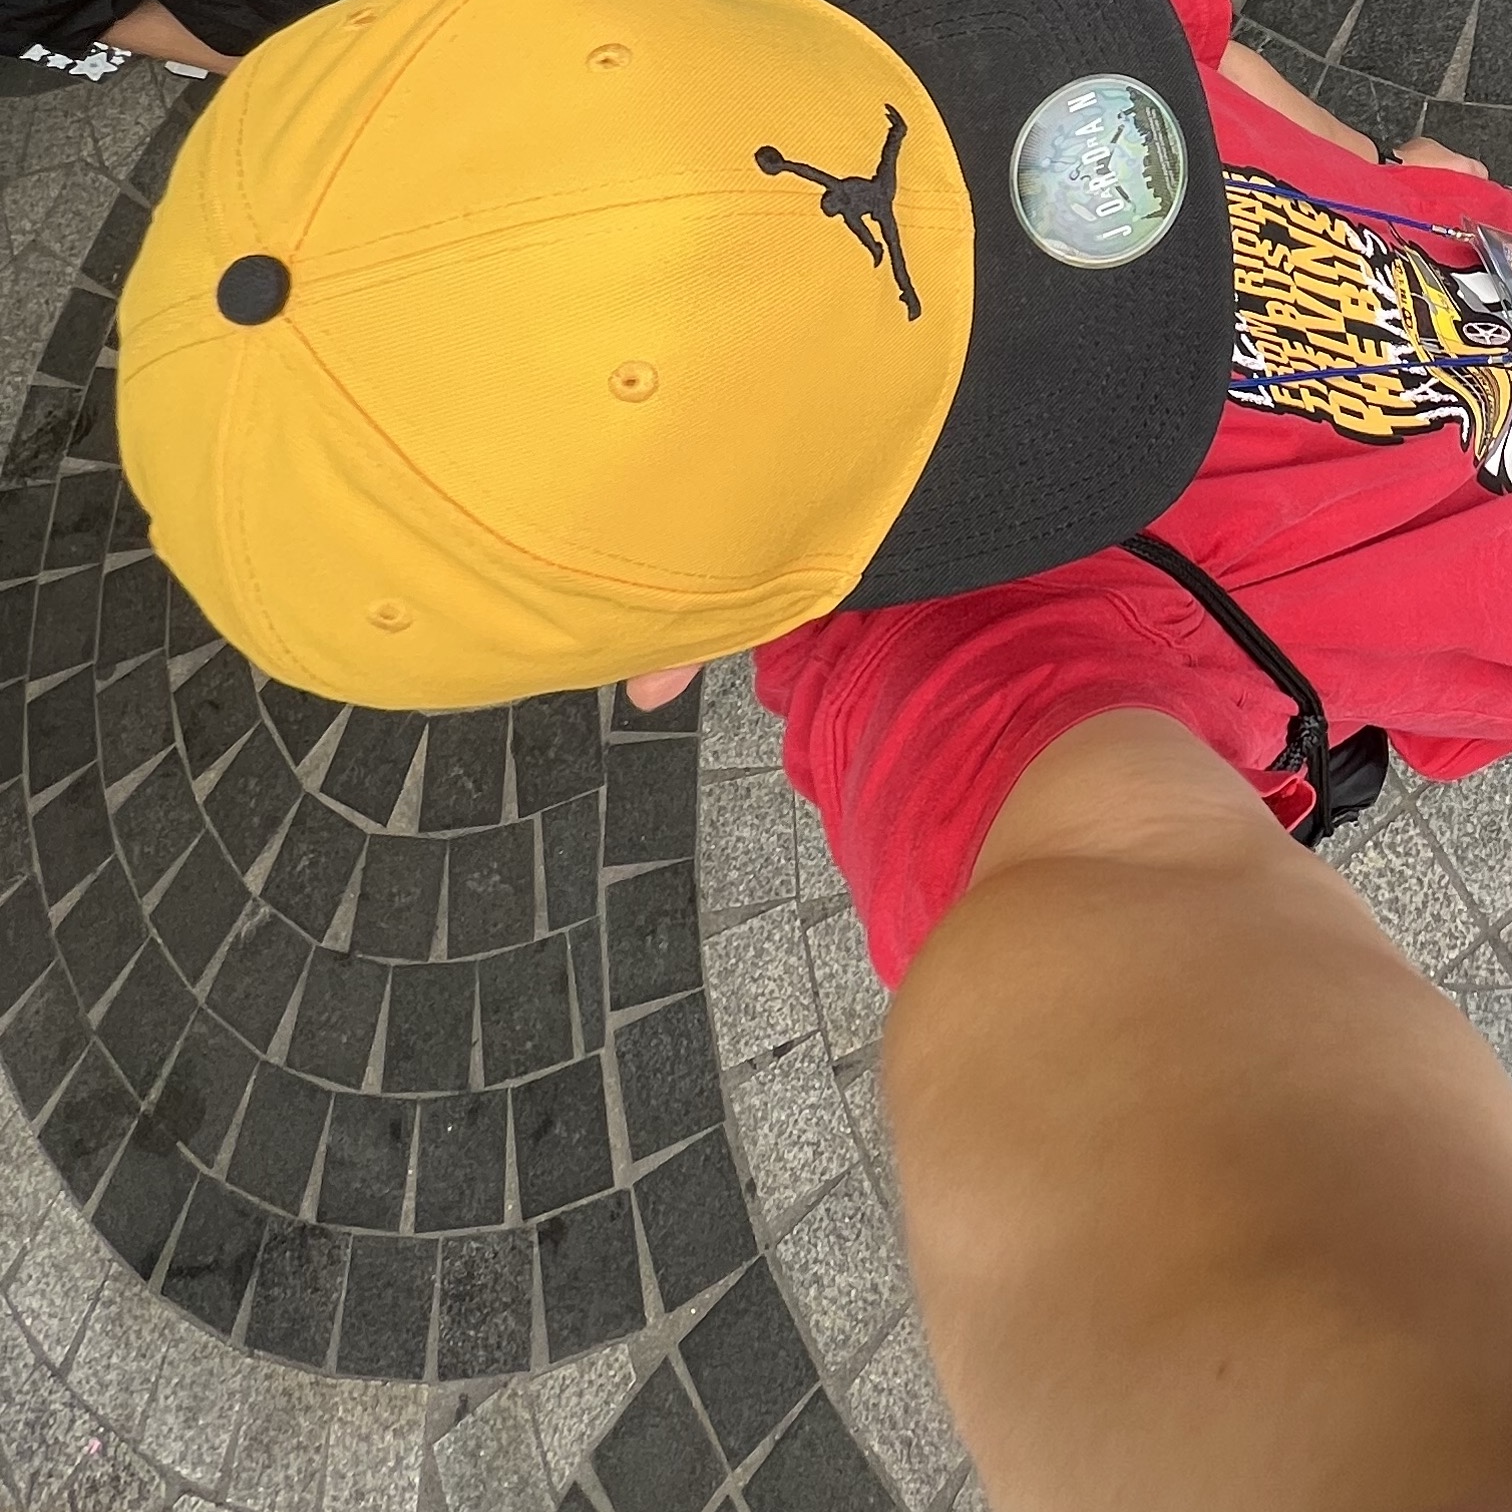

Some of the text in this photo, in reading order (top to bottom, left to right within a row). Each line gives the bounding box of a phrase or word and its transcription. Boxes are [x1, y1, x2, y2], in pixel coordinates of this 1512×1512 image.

[1067, 91, 1133, 240] JORDAN
[1262, 239, 1302, 329] BUS
[1287, 198, 1382, 430] DRIVING
[1327, 218, 1383, 325] BUS
[1240, 309, 1303, 409] FROM
